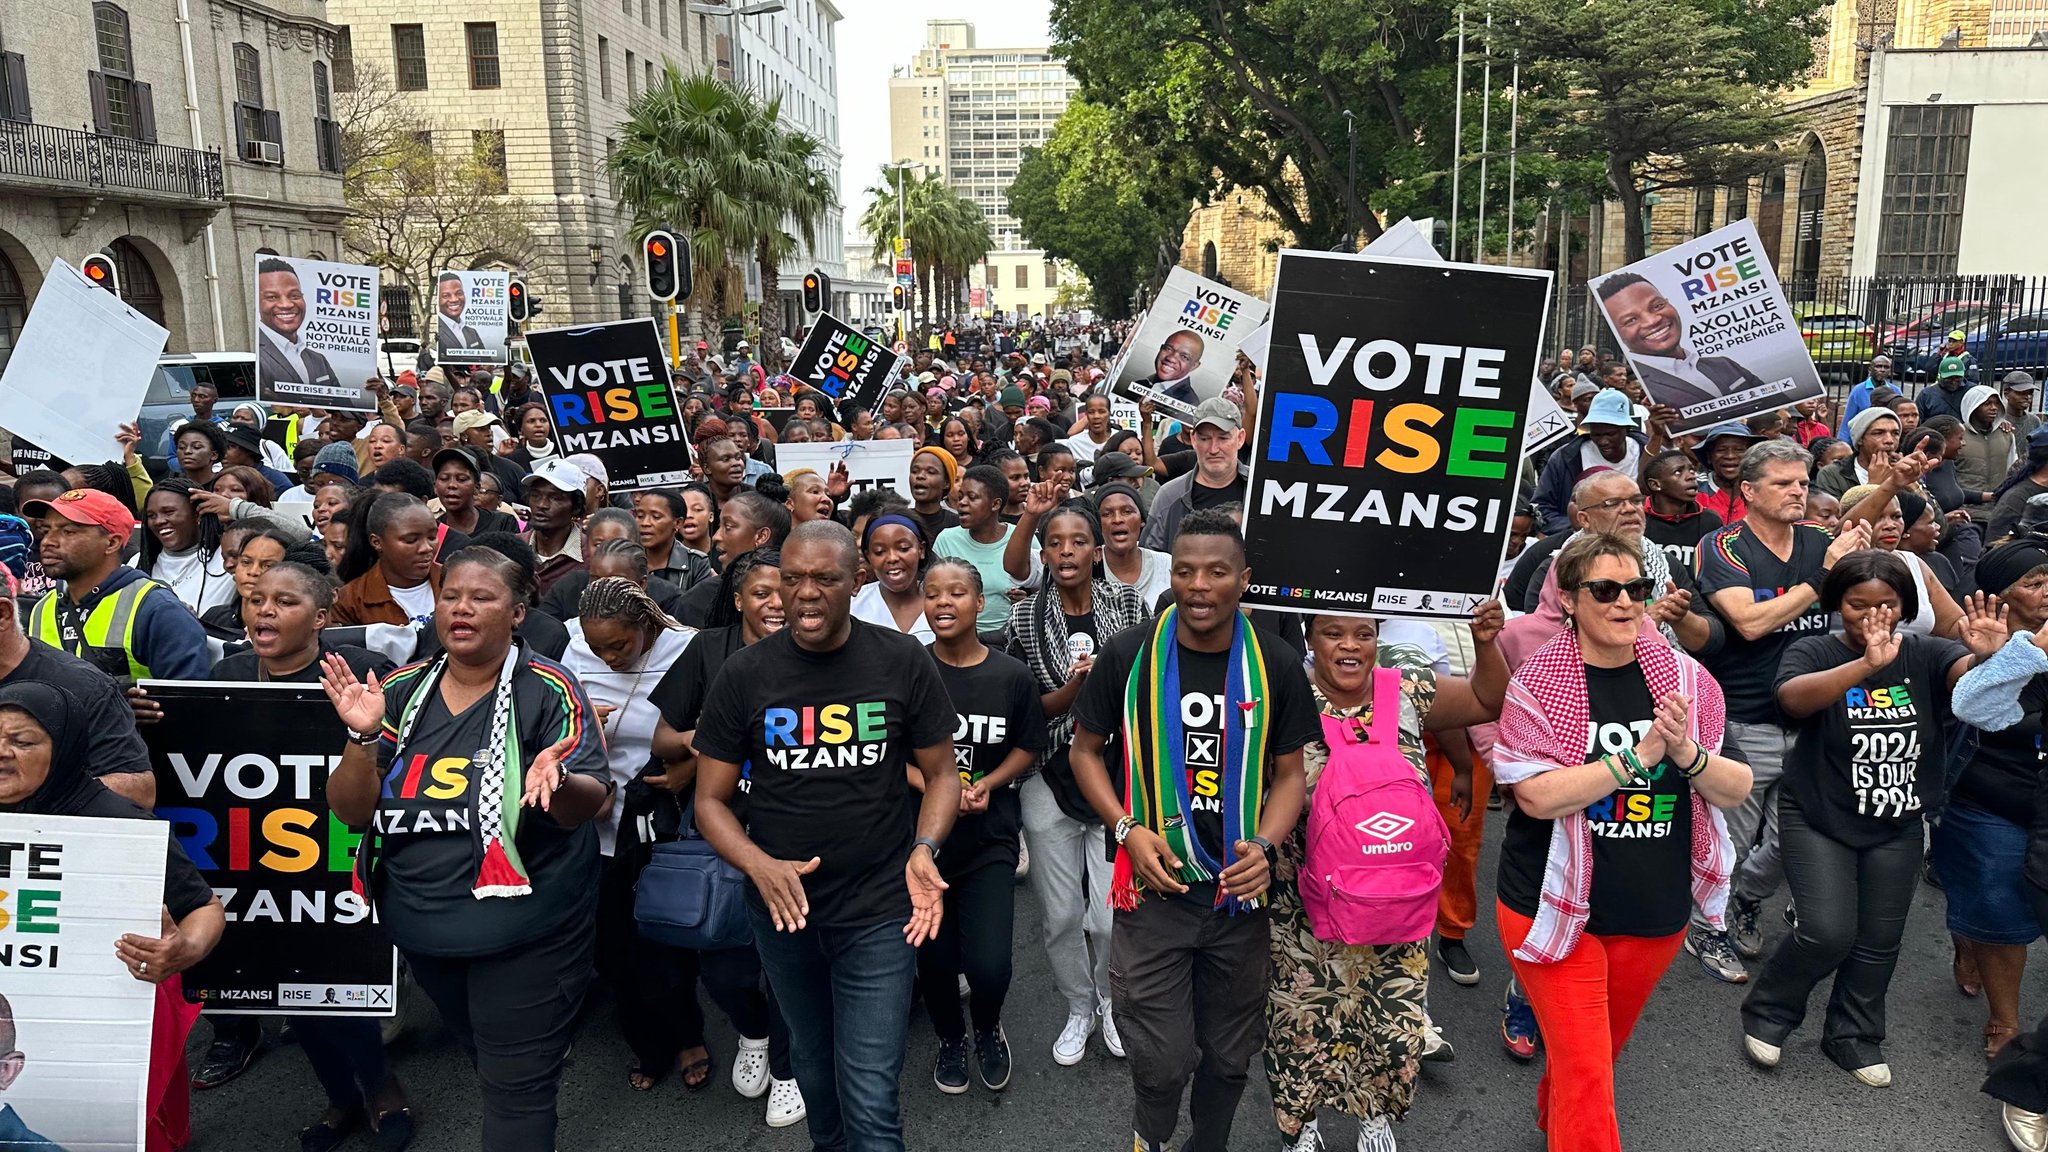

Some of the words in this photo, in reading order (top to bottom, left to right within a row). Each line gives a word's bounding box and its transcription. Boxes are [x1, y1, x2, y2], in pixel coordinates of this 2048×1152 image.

[1673, 237, 1751, 277] VOTE
[318, 272, 370, 290] VOTE
[472, 288, 504, 297] RISE
[473, 278, 504, 286] VOTE
[1681, 256, 1760, 301] RISE
[316, 288, 370, 308] RISE
[1195, 286, 1241, 315] VOTE
[1691, 279, 1768, 314] MZANSI
[316, 306, 370, 320] MZANSI
[1183, 299, 1234, 330] RISE
[1689, 297, 1777, 338] AXOLILE
[306, 321, 370, 336] AXOLILE
[306, 332, 370, 346] NOTYWALA
[1178, 316, 1225, 341] MZANSI
[1692, 312, 1782, 348] NOTYWALA
[1697, 342, 1724, 357] FOR
[1727, 322, 1786, 348] PREMIER
[306, 341, 325, 349] FOR
[328, 344, 370, 354] PREMIER
[809, 329, 847, 380] VOTE
[548, 357, 654, 390] VOTE
[821, 333, 868, 398] RISE
[843, 345, 881, 401] MZANSI
[1297, 333, 1506, 399] VOTE
[277, 383, 301, 392] VOTE
[1132, 384, 1151, 396] VOTE
[1152, 393, 1168, 401] RISE
[551, 384, 673, 427] RISE
[1110, 410, 1136, 418] VOTE
[1684, 402, 1716, 416] VOTE
[1719, 394, 1745, 406] RISE
[563, 424, 680, 452] MZANSI
[1267, 392, 1516, 479] RISE
[13, 449, 23, 458] WE
[24, 450, 51, 460] NEED
[1260, 479, 1501, 533] MZANSI
[1280, 586, 1311, 598] RISE
[1314, 591, 1368, 603] MZANSI
[1378, 595, 1407, 605] RISE
[1846, 685, 1912, 708] RISE
[764, 701, 887, 746] RISE
[1847, 704, 1916, 719] MZANSI
[953, 713, 1006, 744] OTE
[766, 742, 887, 770] MZANSI
[1851, 730, 1921, 764] 2024
[167, 753, 343, 799] VOT
[1852, 763, 1874, 788] IS
[1878, 761, 1916, 787] OUR
[1587, 794, 1677, 822] RISE
[1855, 783, 1921, 818] 1994
[1587, 820, 1671, 838] MZANSI
[1362, 841, 1413, 854] umbro
[187, 989, 216, 999] RISE
[220, 990, 272, 1000] MZANSI
[283, 990, 311, 1000] RISE
